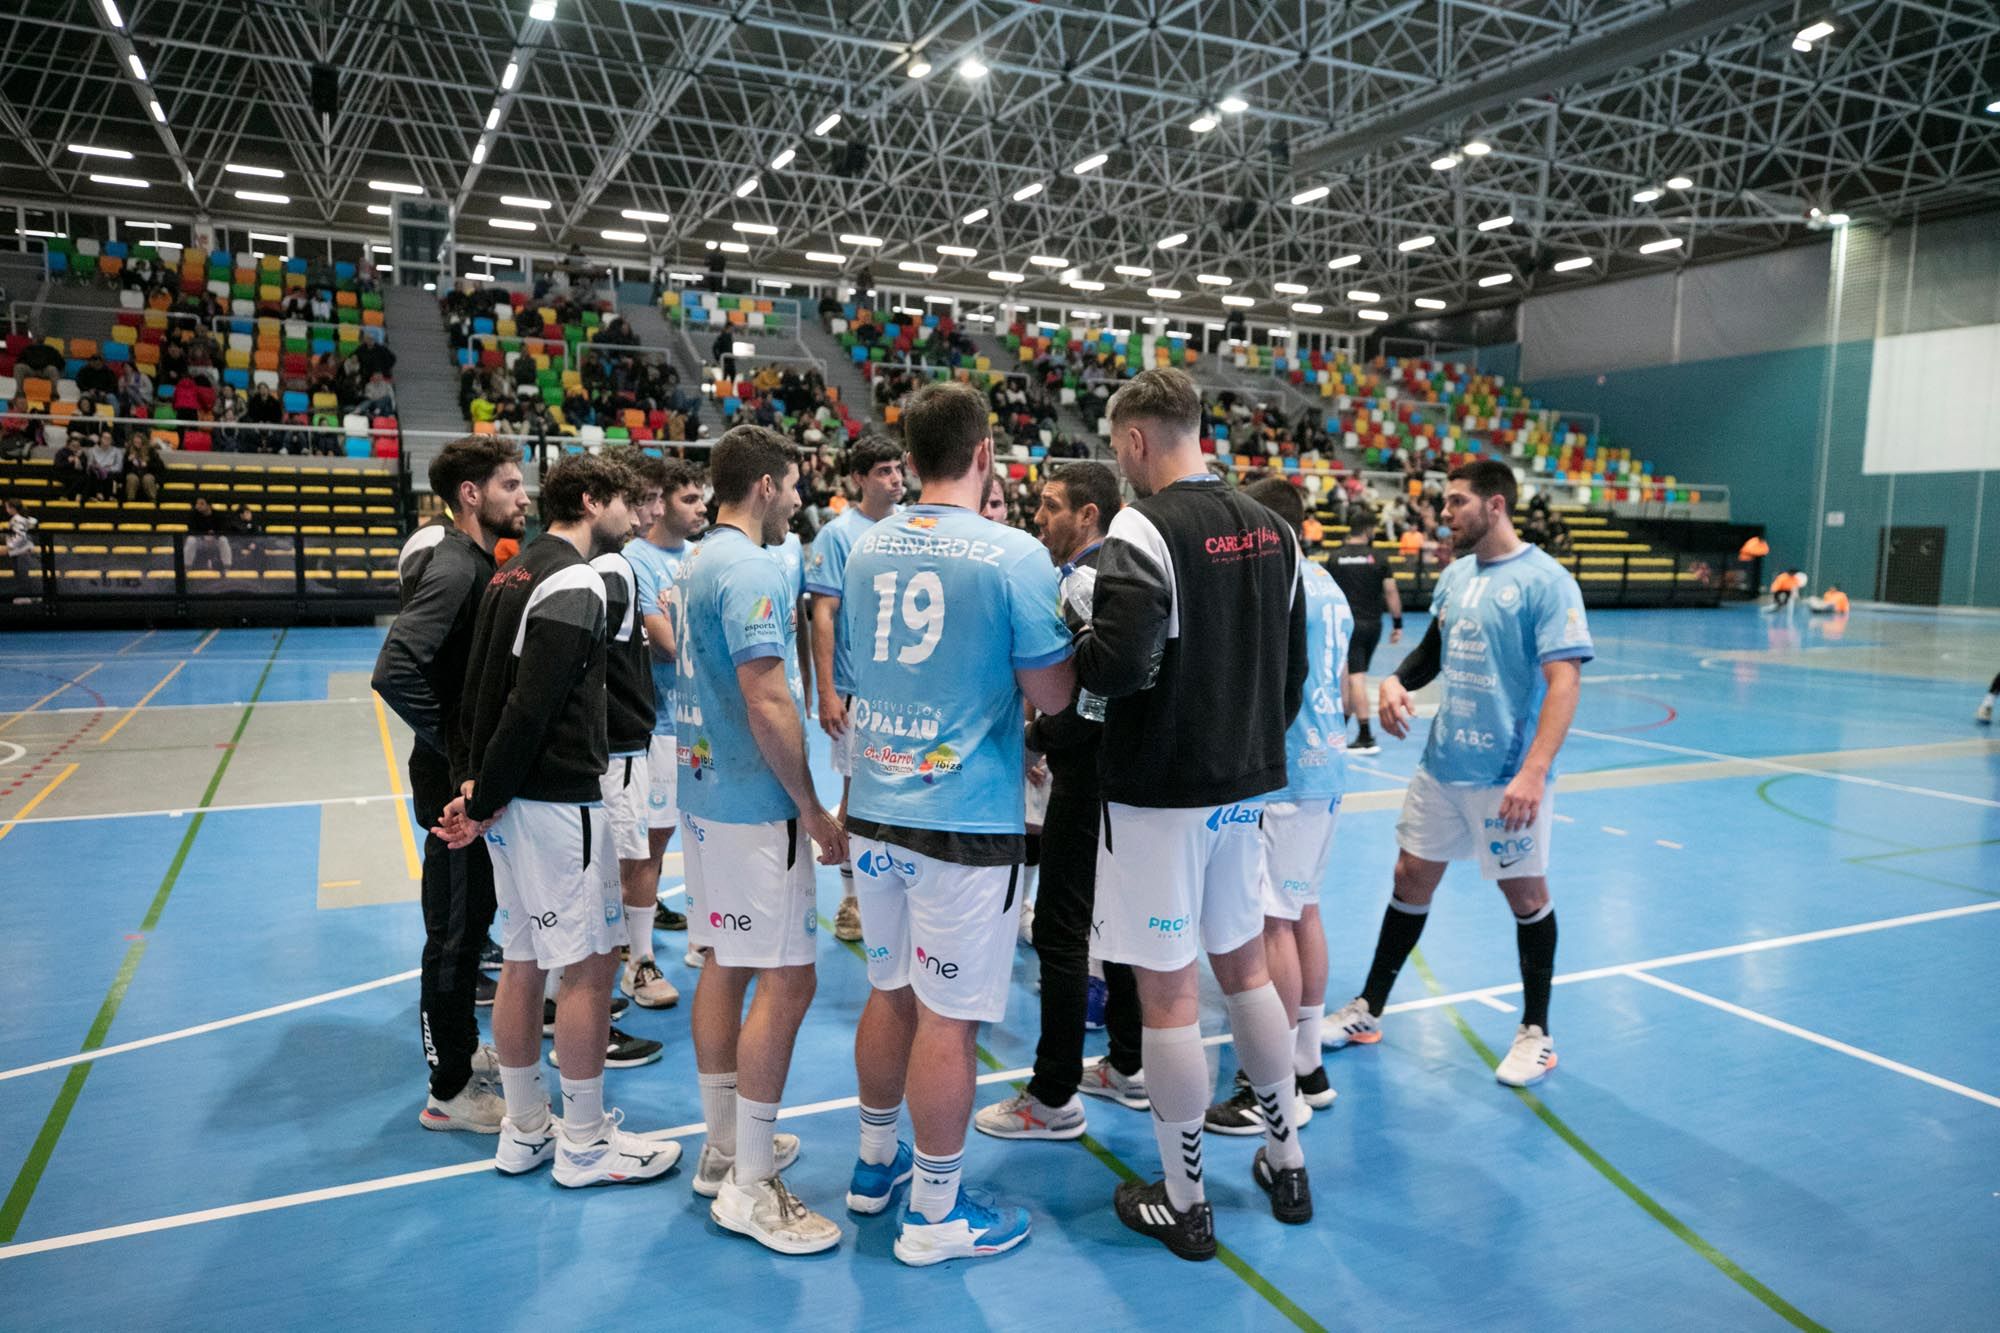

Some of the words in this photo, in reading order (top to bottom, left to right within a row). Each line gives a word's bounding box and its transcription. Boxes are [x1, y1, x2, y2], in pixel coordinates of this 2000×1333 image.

[862, 534, 1006, 567] BERNARDEZ
[1461, 576, 1490, 608] 11
[745, 623, 776, 632] esports
[873, 570, 945, 665] 19
[869, 711, 939, 741] PALAU
[1489, 836, 1535, 856] one
[529, 911, 558, 931] ne
[709, 911, 752, 932] one
[915, 946, 960, 980] one
